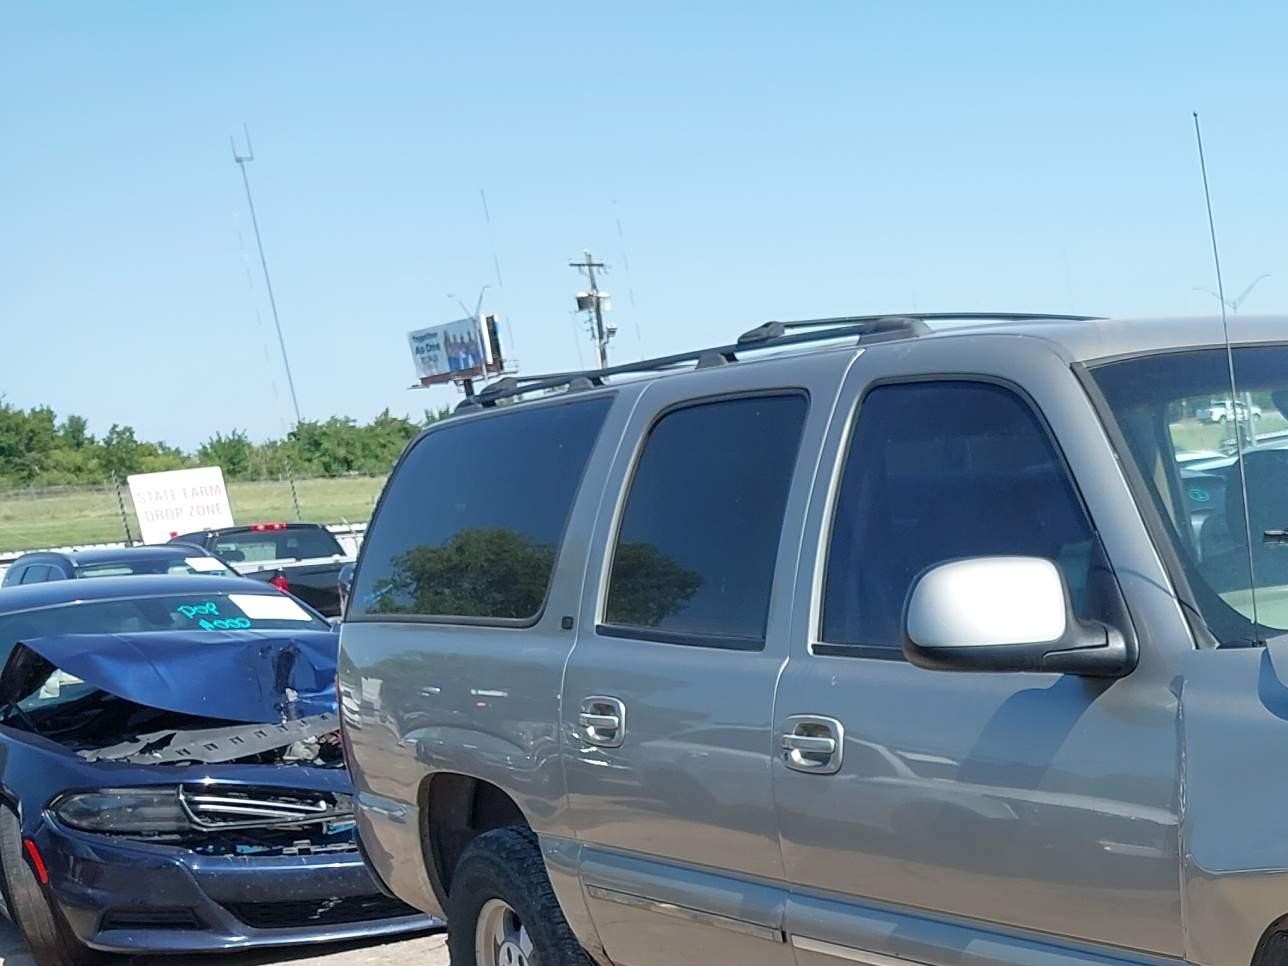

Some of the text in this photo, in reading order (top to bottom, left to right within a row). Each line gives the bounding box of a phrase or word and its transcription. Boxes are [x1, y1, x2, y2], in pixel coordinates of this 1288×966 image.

[136, 484, 222, 504] STATE FARM
[144, 502, 223, 521] DROP ZONE
